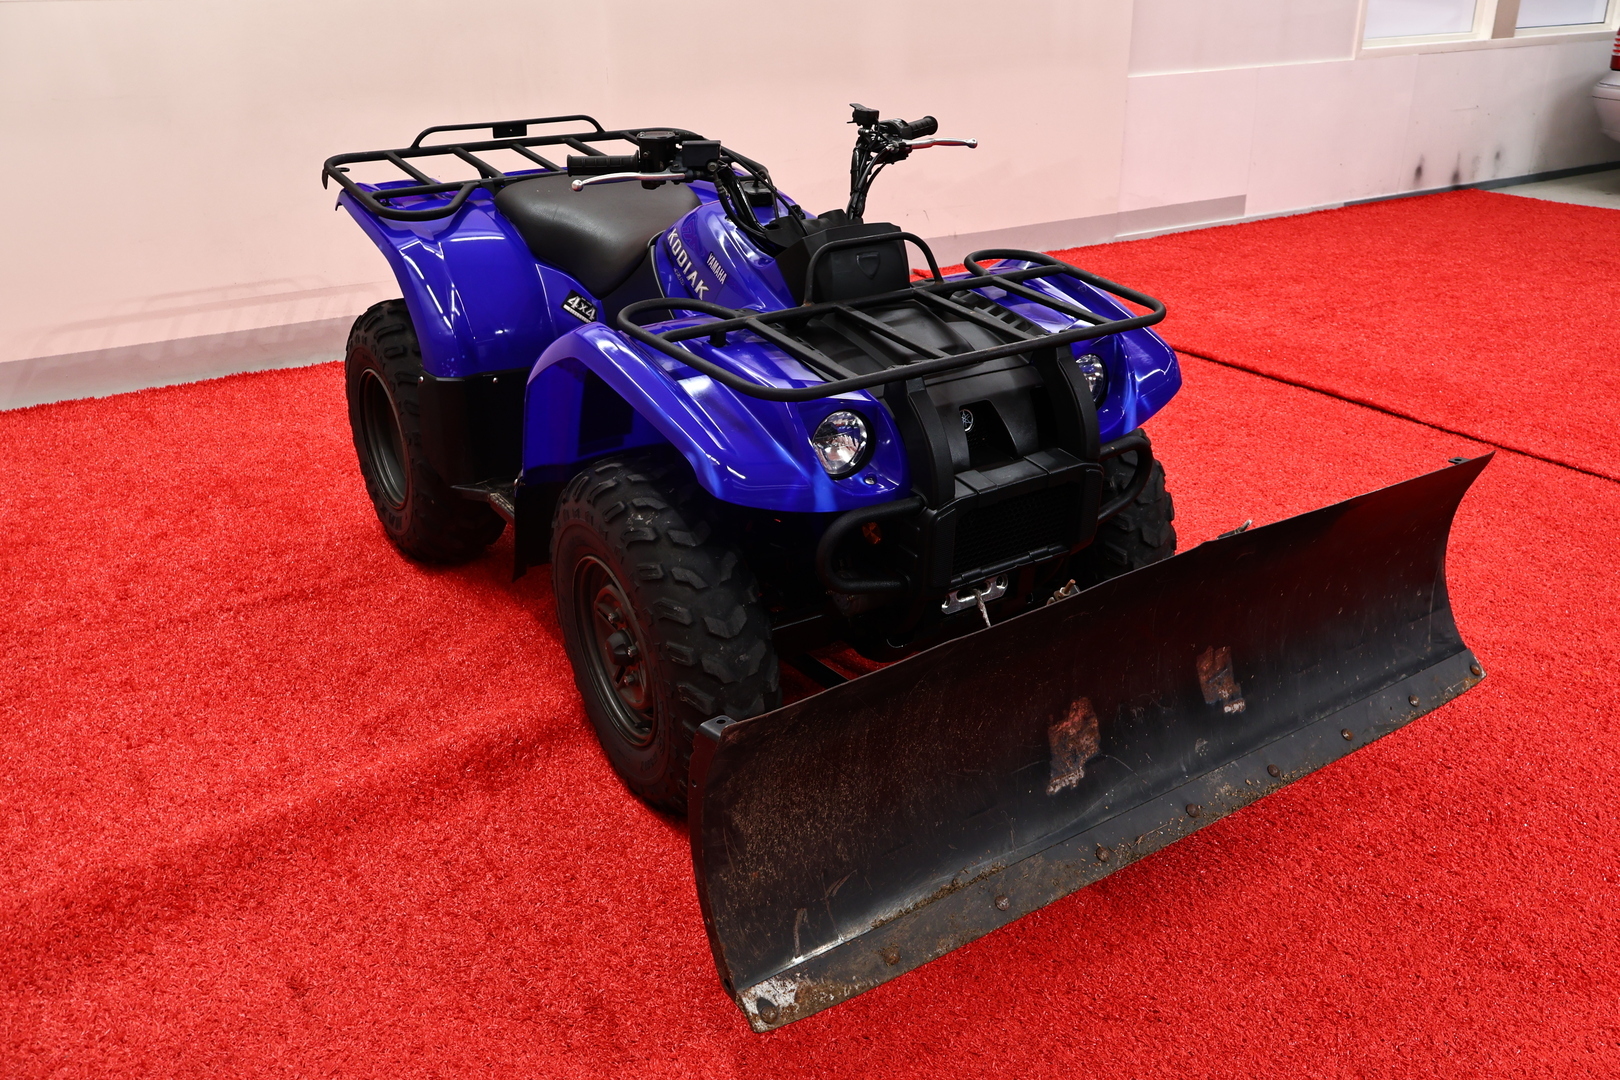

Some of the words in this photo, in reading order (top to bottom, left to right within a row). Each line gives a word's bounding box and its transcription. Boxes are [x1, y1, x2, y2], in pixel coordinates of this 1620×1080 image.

[667, 228, 709, 300] KODIAK
[706, 252, 727, 285] YAMAHA
[566, 295, 596, 321] 4x4
